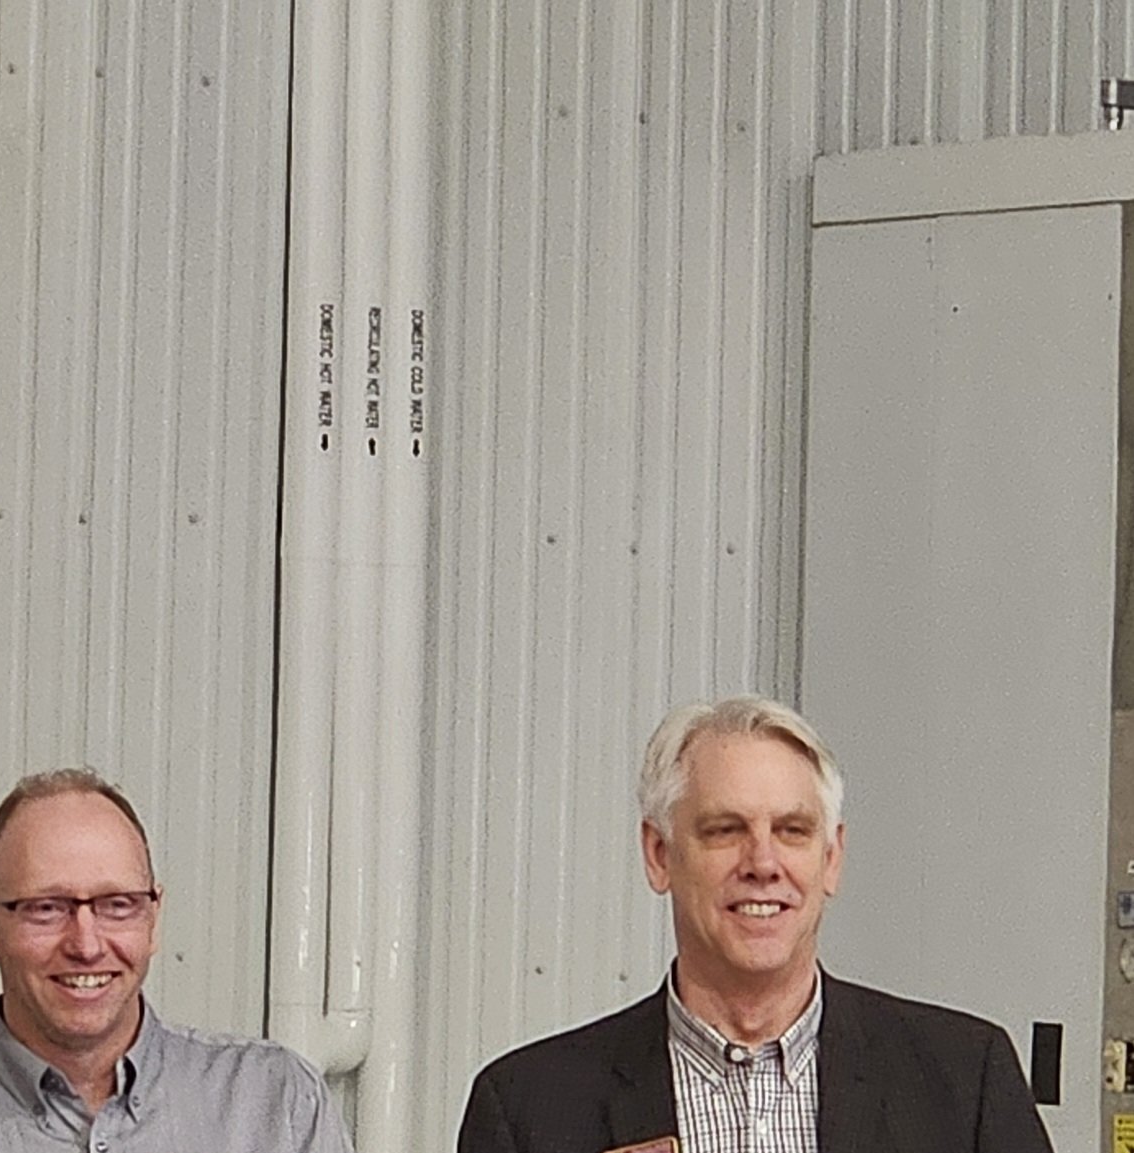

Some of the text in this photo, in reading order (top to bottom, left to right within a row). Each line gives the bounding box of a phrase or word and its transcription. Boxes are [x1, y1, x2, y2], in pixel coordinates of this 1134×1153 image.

[318, 304, 334, 426] DOMESTIC HOT WATER
[366, 400, 380, 428] WATER
[410, 310, 423, 433] DOMESTIC COLD WATER
